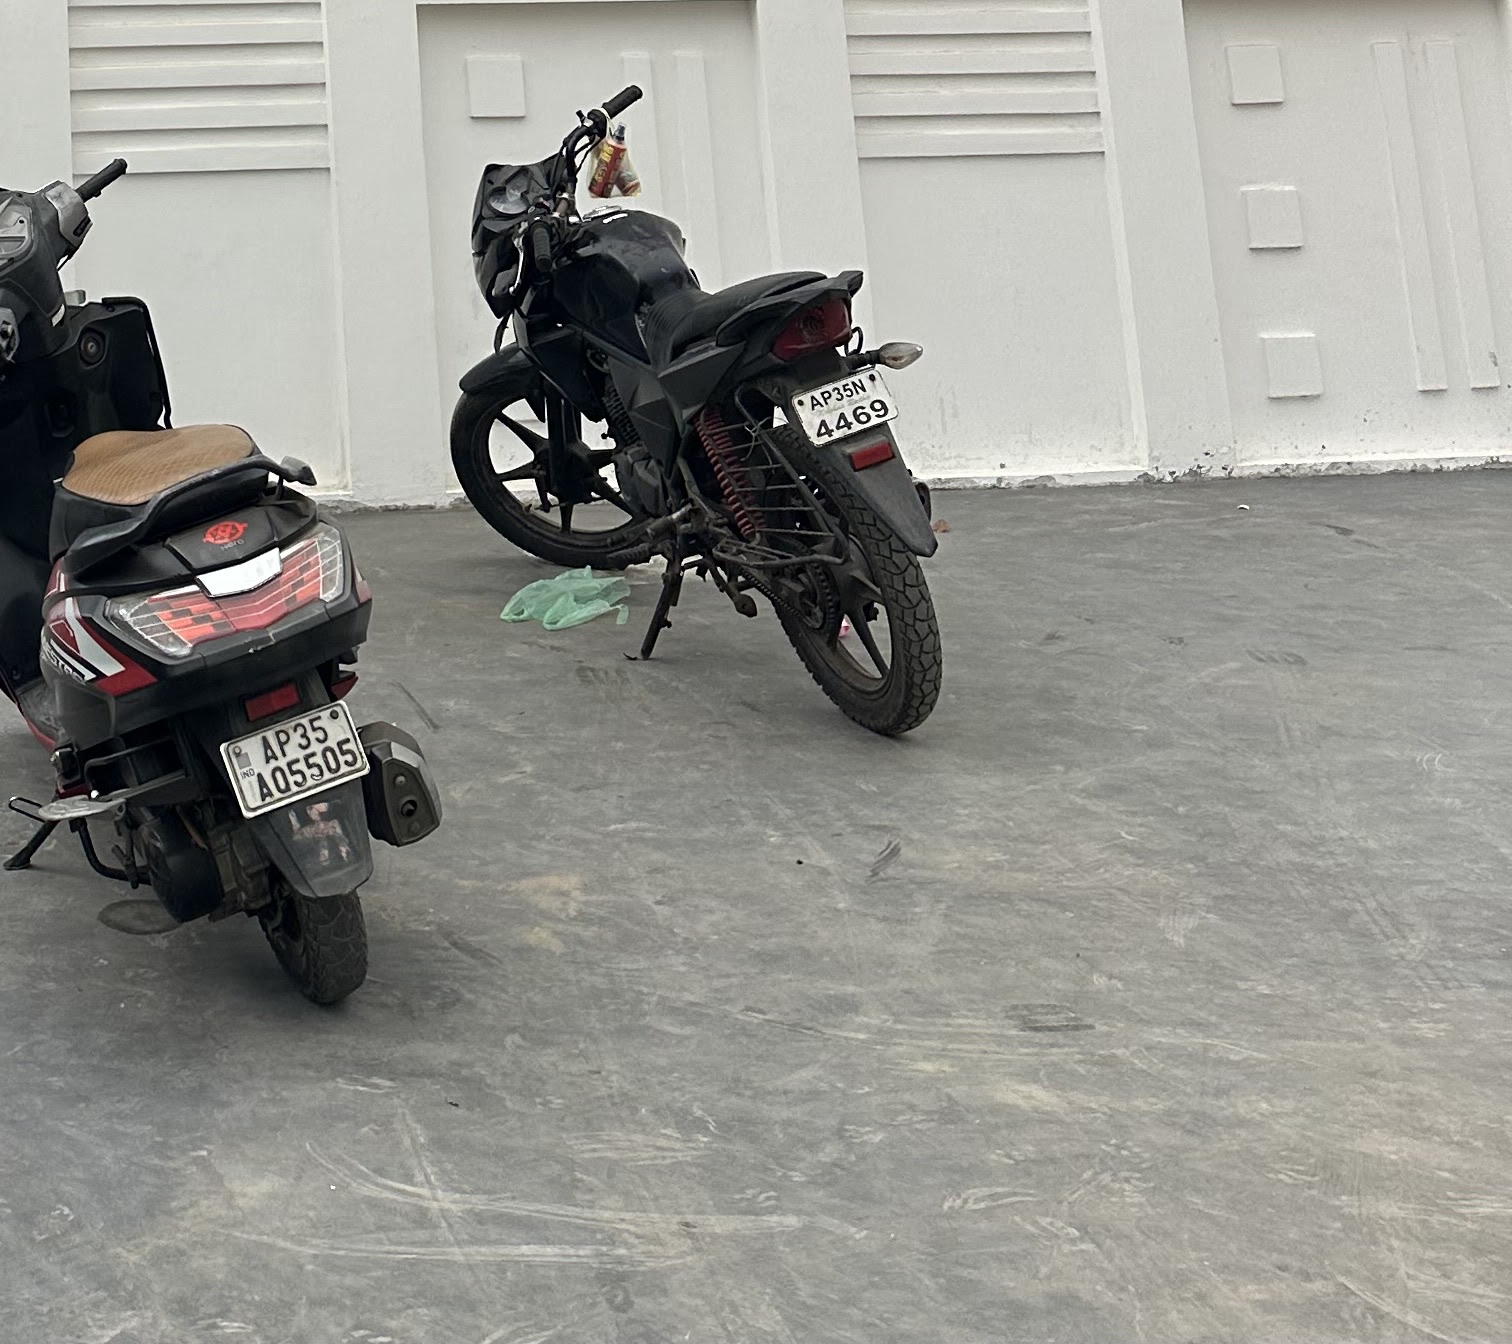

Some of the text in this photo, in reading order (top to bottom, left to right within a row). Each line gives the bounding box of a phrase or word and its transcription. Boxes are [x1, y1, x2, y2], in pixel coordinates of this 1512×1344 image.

[810, 378, 867, 411] AP35N
[816, 399, 889, 438] 4469
[261, 715, 328, 764] AP35
